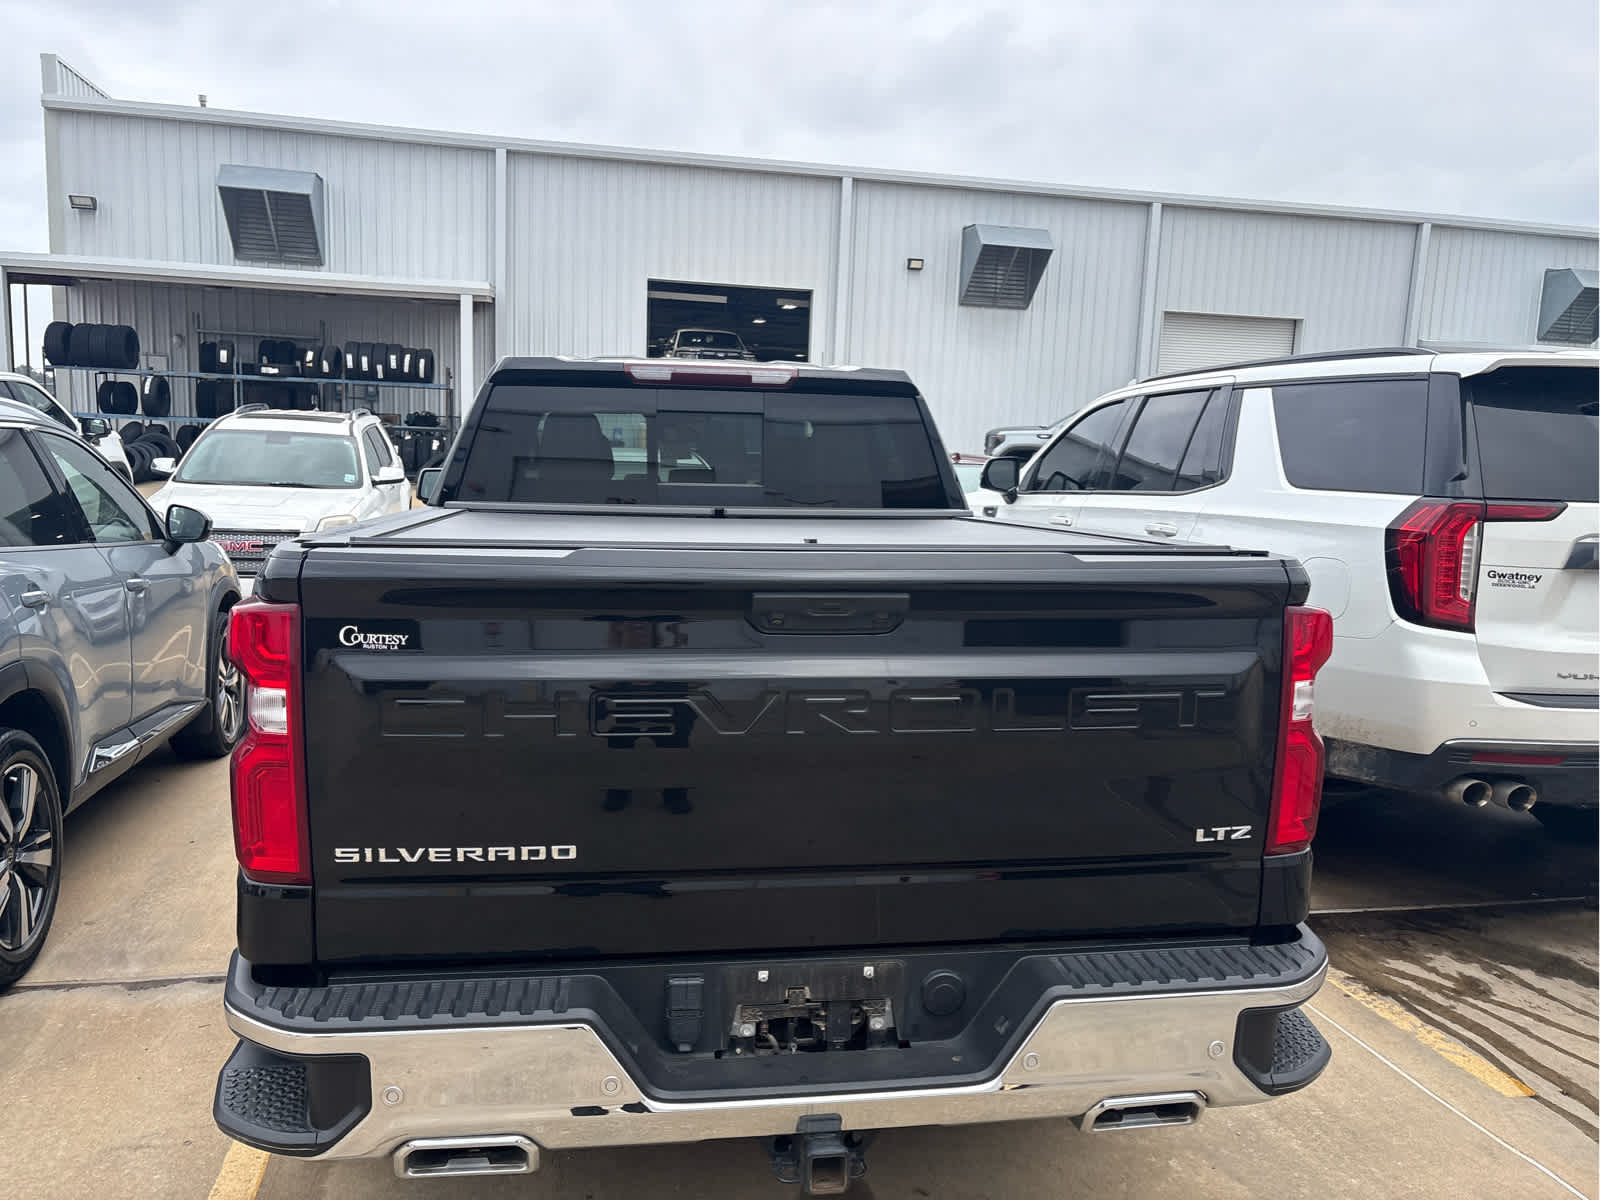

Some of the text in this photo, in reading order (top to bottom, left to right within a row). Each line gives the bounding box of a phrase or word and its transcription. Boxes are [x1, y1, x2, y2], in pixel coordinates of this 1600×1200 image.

[1487, 570, 1543, 583] Gwatney
[339, 625, 408, 646] COURTESY
[379, 688, 1228, 737] CHEVROLET
[1195, 825, 1252, 842] LTZ
[334, 845, 577, 863] SILVERADO
